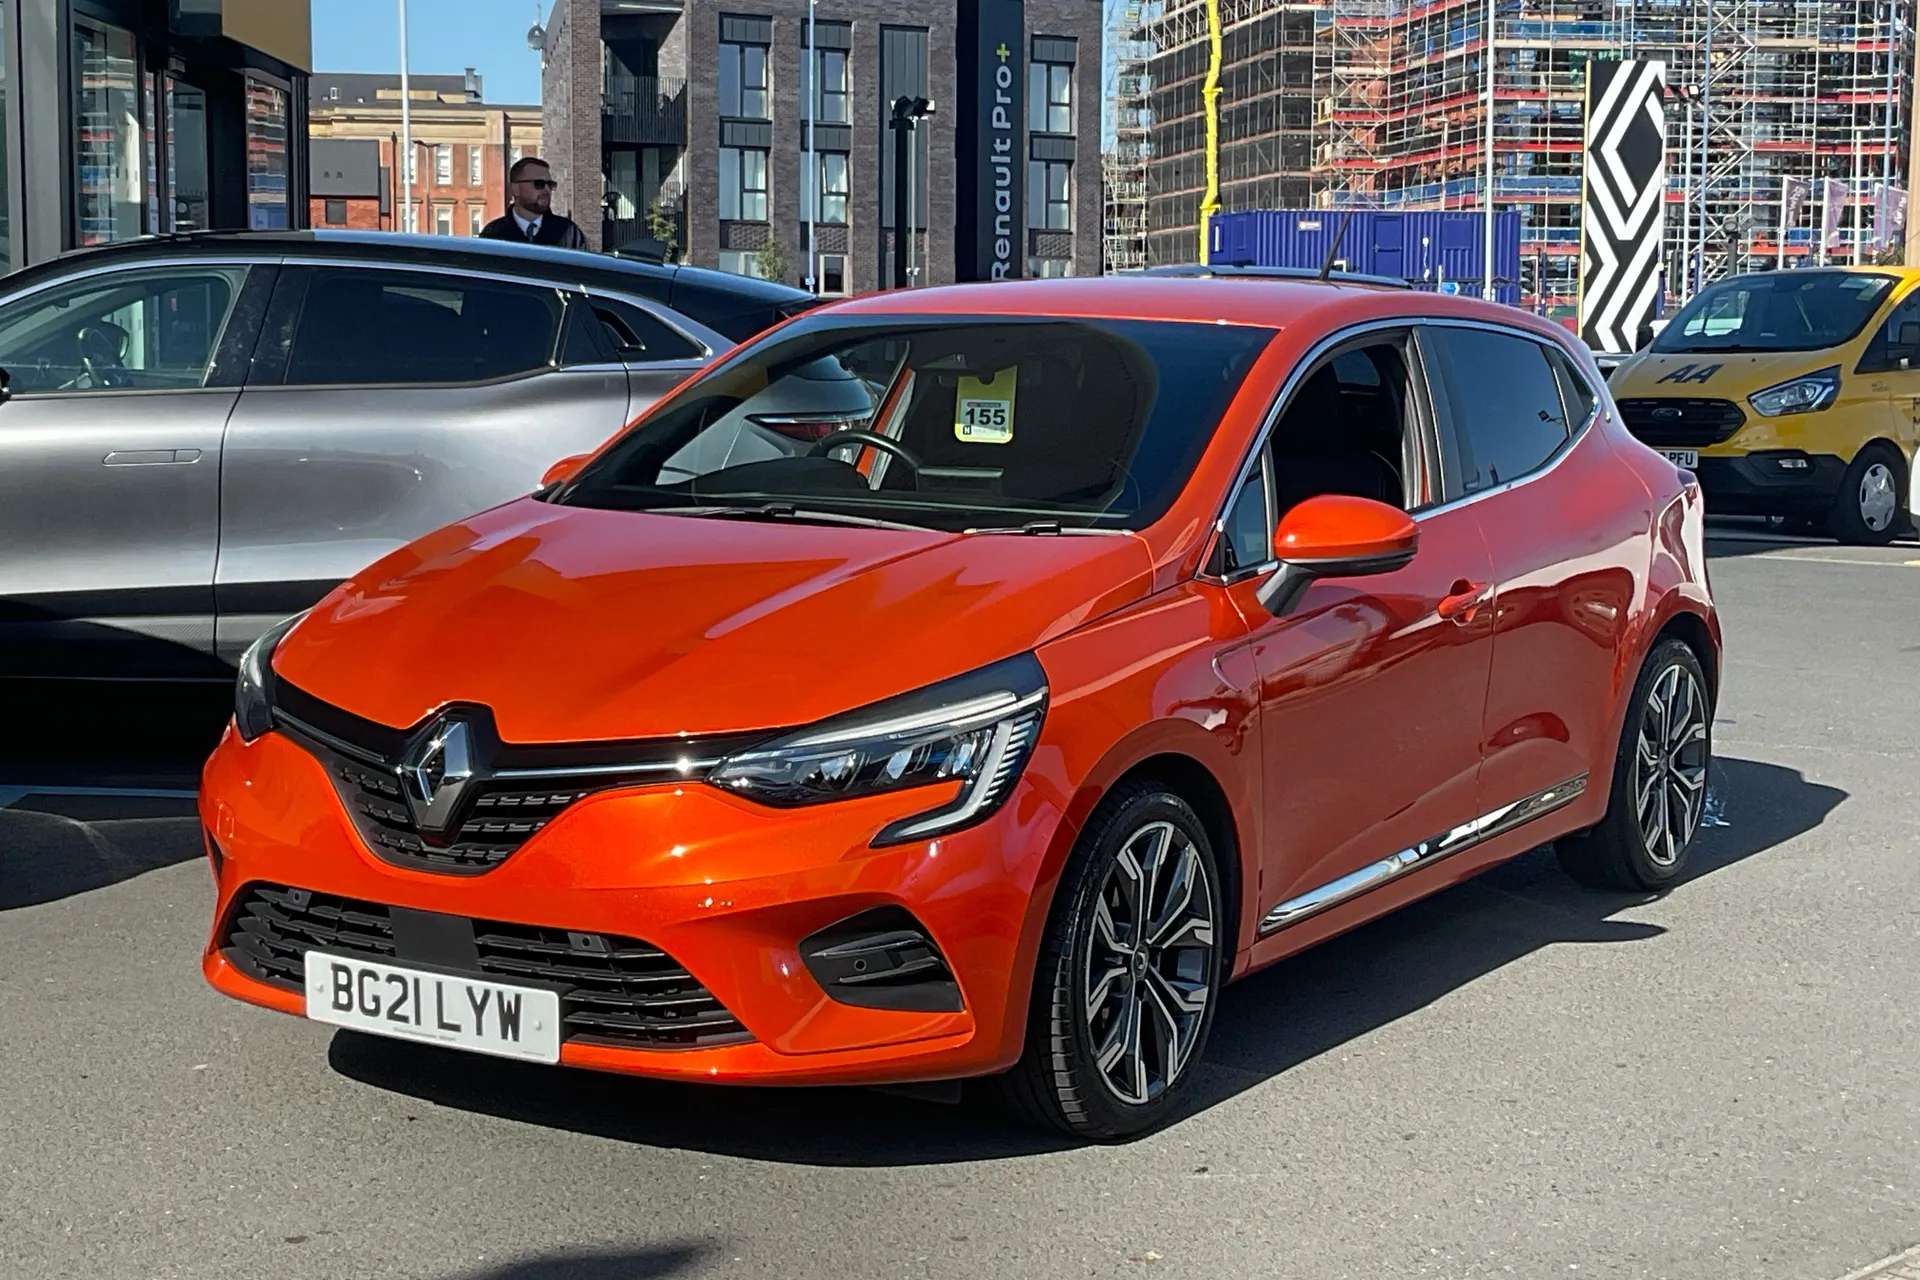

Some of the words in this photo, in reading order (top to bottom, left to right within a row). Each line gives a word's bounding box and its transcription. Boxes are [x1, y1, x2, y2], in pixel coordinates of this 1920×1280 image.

[991, 43, 1011, 135] Pro+
[991, 138, 1011, 280] Renault
[1656, 363, 1724, 384] AA
[965, 408, 1006, 425] 155
[1669, 452, 1694, 466] PFU
[331, 962, 421, 1026] BG21
[436, 981, 522, 1042] LYW
